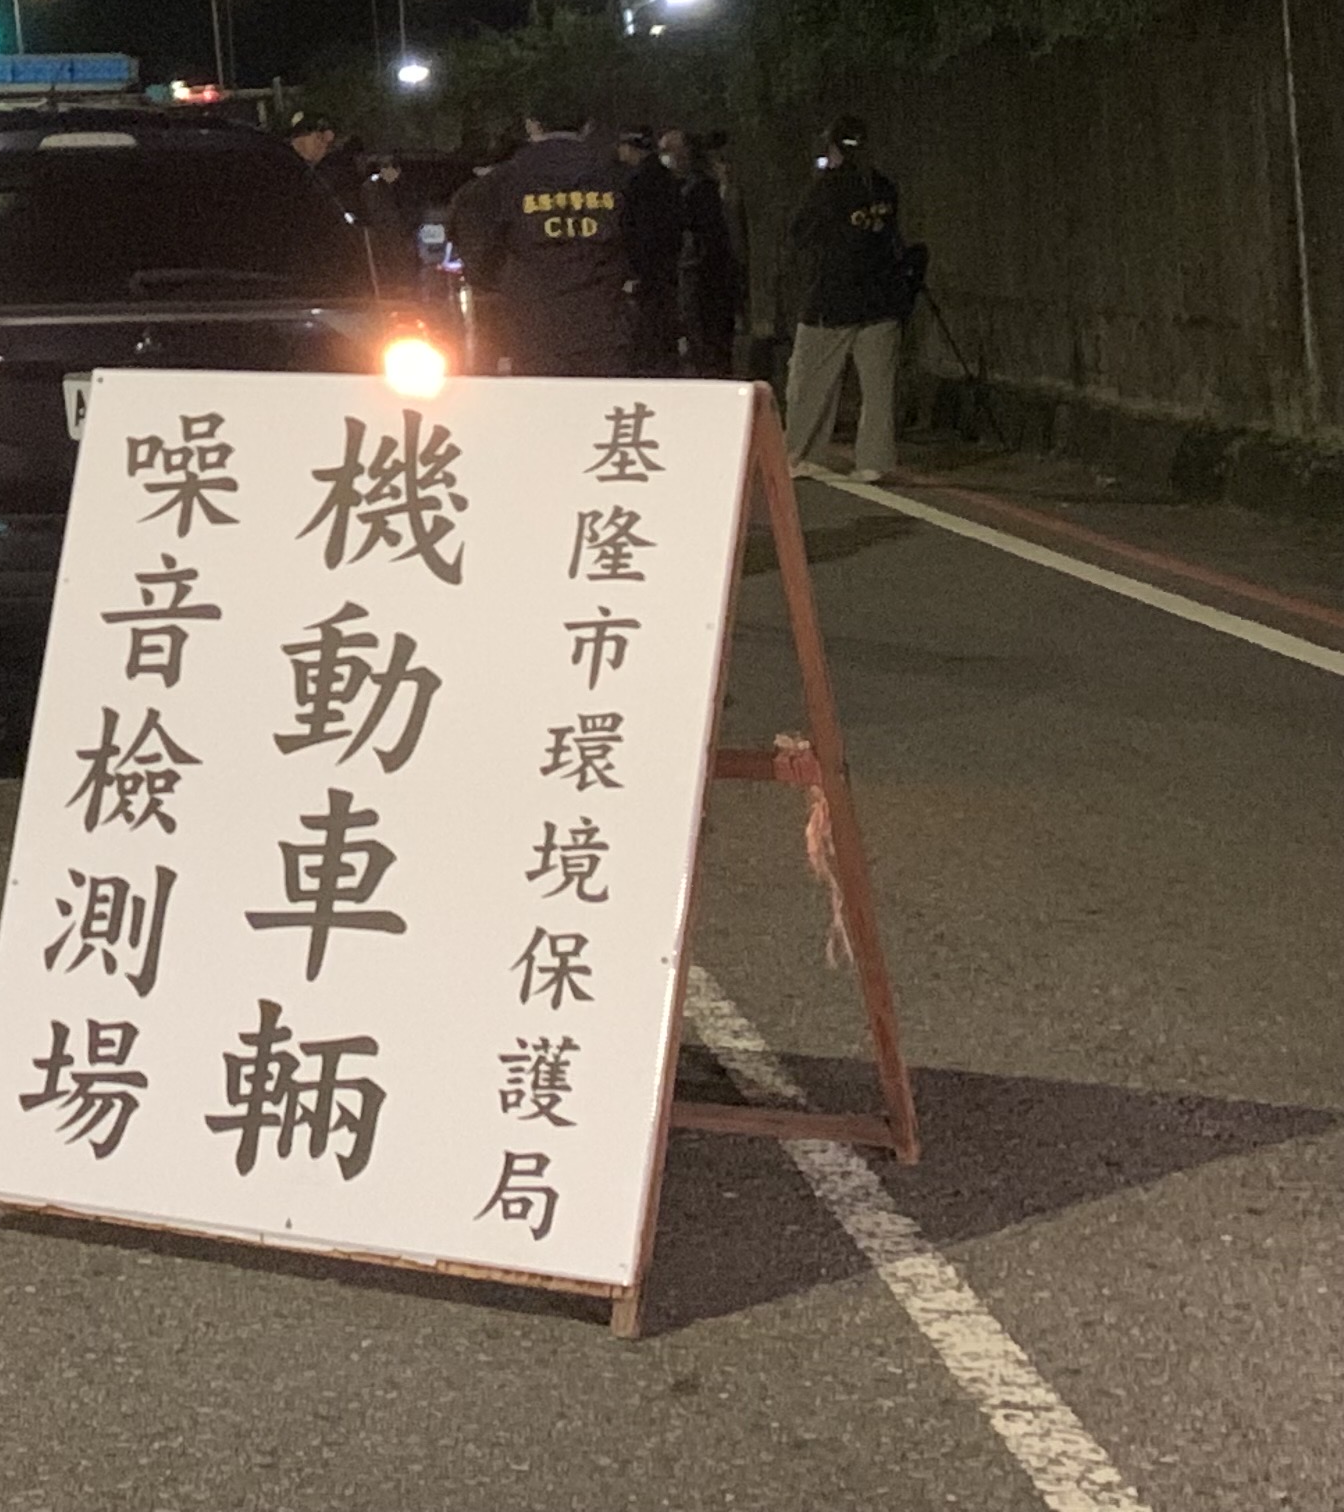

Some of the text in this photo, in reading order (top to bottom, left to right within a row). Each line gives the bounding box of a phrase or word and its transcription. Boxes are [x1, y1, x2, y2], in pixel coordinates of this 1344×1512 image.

[544, 216, 598, 238] CID
[18, 411, 240, 1160] 噪音檢測場
[204, 409, 470, 1182] 機動車輛
[474, 401, 668, 1242] 基隆市環境保護局
